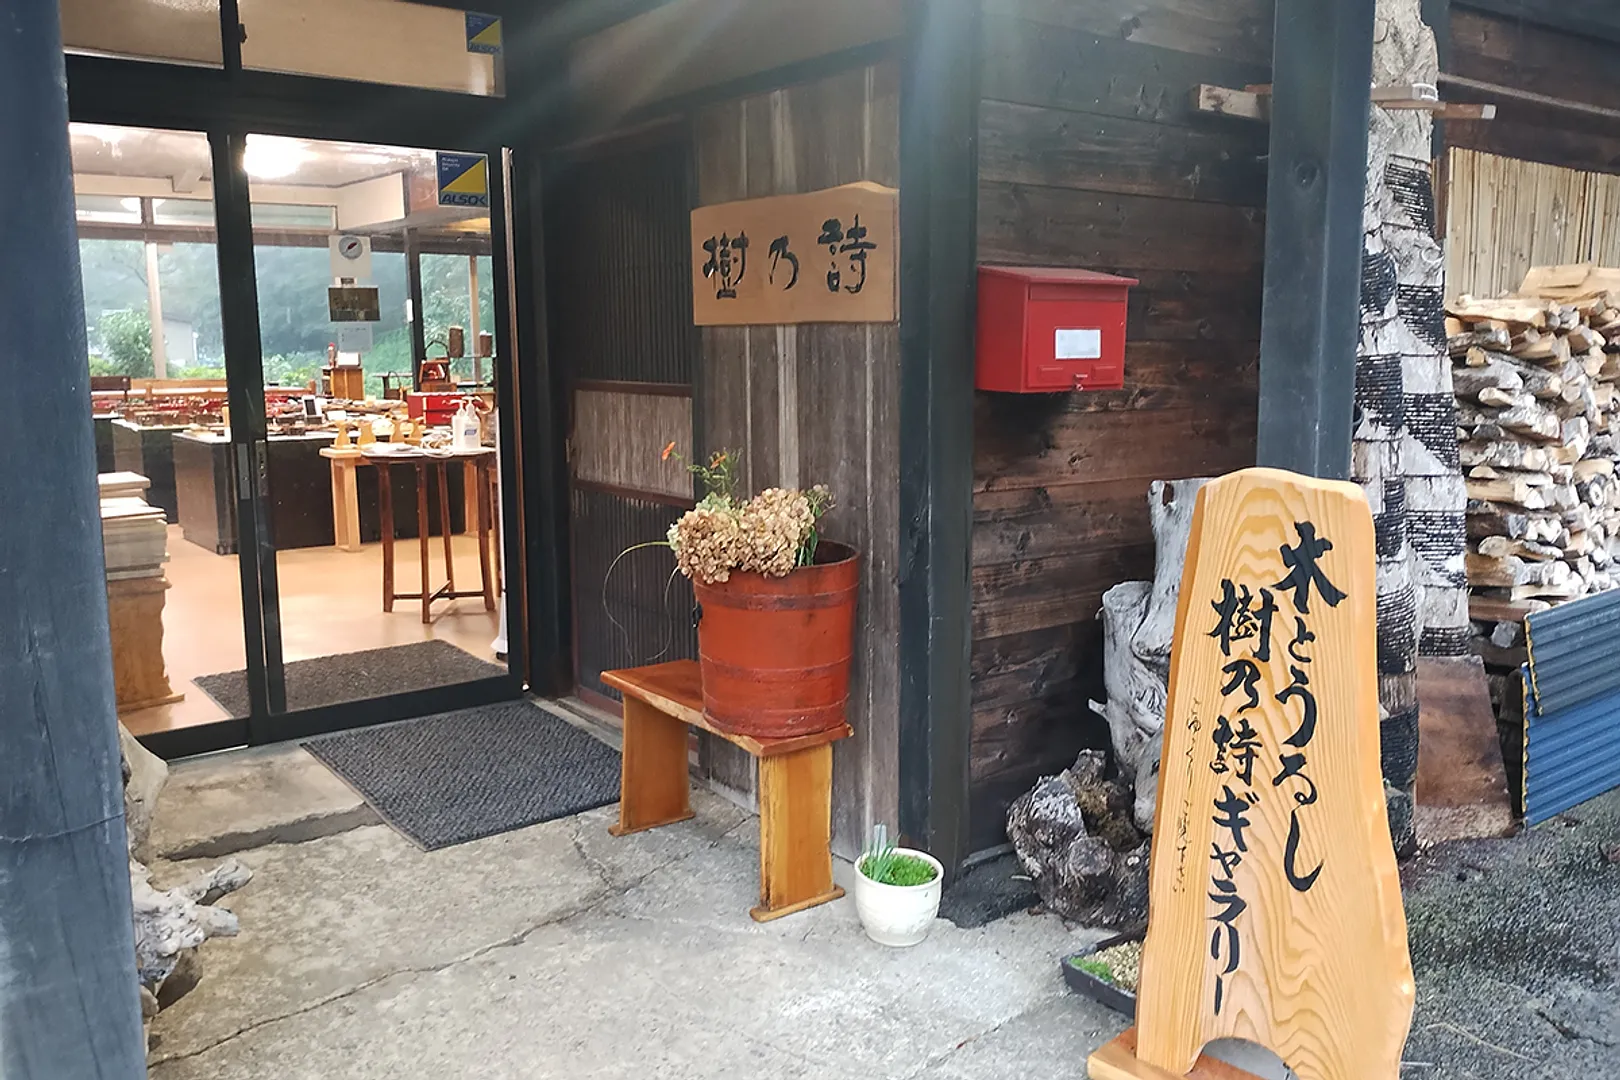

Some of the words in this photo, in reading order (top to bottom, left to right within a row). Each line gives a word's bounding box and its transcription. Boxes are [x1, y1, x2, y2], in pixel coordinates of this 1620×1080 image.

[441, 193, 486, 206] ALSOK
[702, 213, 877, 300] 樹乃詩
[1207, 578, 1278, 1016] 樹乃詩ギャラリー
[1271, 521, 1348, 893] 木とうるし
